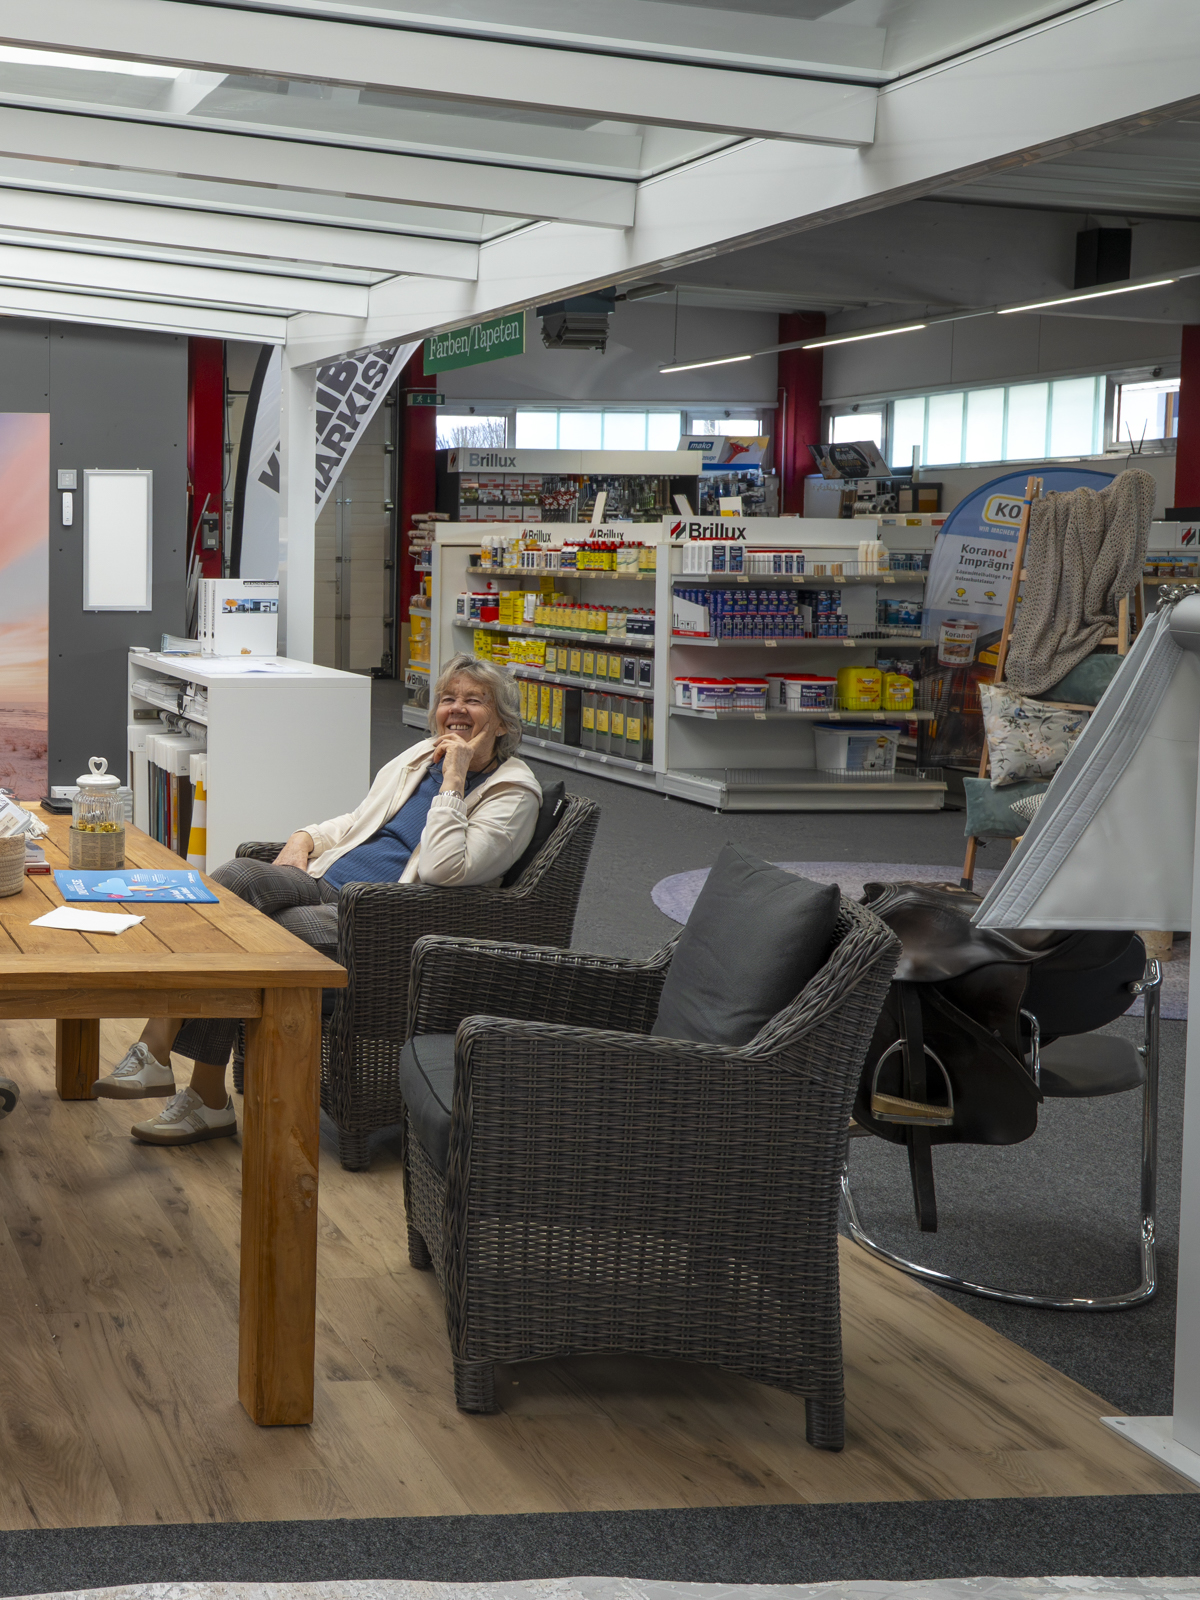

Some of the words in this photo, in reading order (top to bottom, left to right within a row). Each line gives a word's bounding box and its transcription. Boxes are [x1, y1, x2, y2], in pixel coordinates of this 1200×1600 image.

[429, 320, 520, 360] Farben/Tapeten
[690, 441, 712, 449] mako
[469, 453, 517, 468] Brillux
[528, 529, 552, 543] Brillux
[597, 529, 625, 540] Brillux
[689, 522, 747, 540] Brillux
